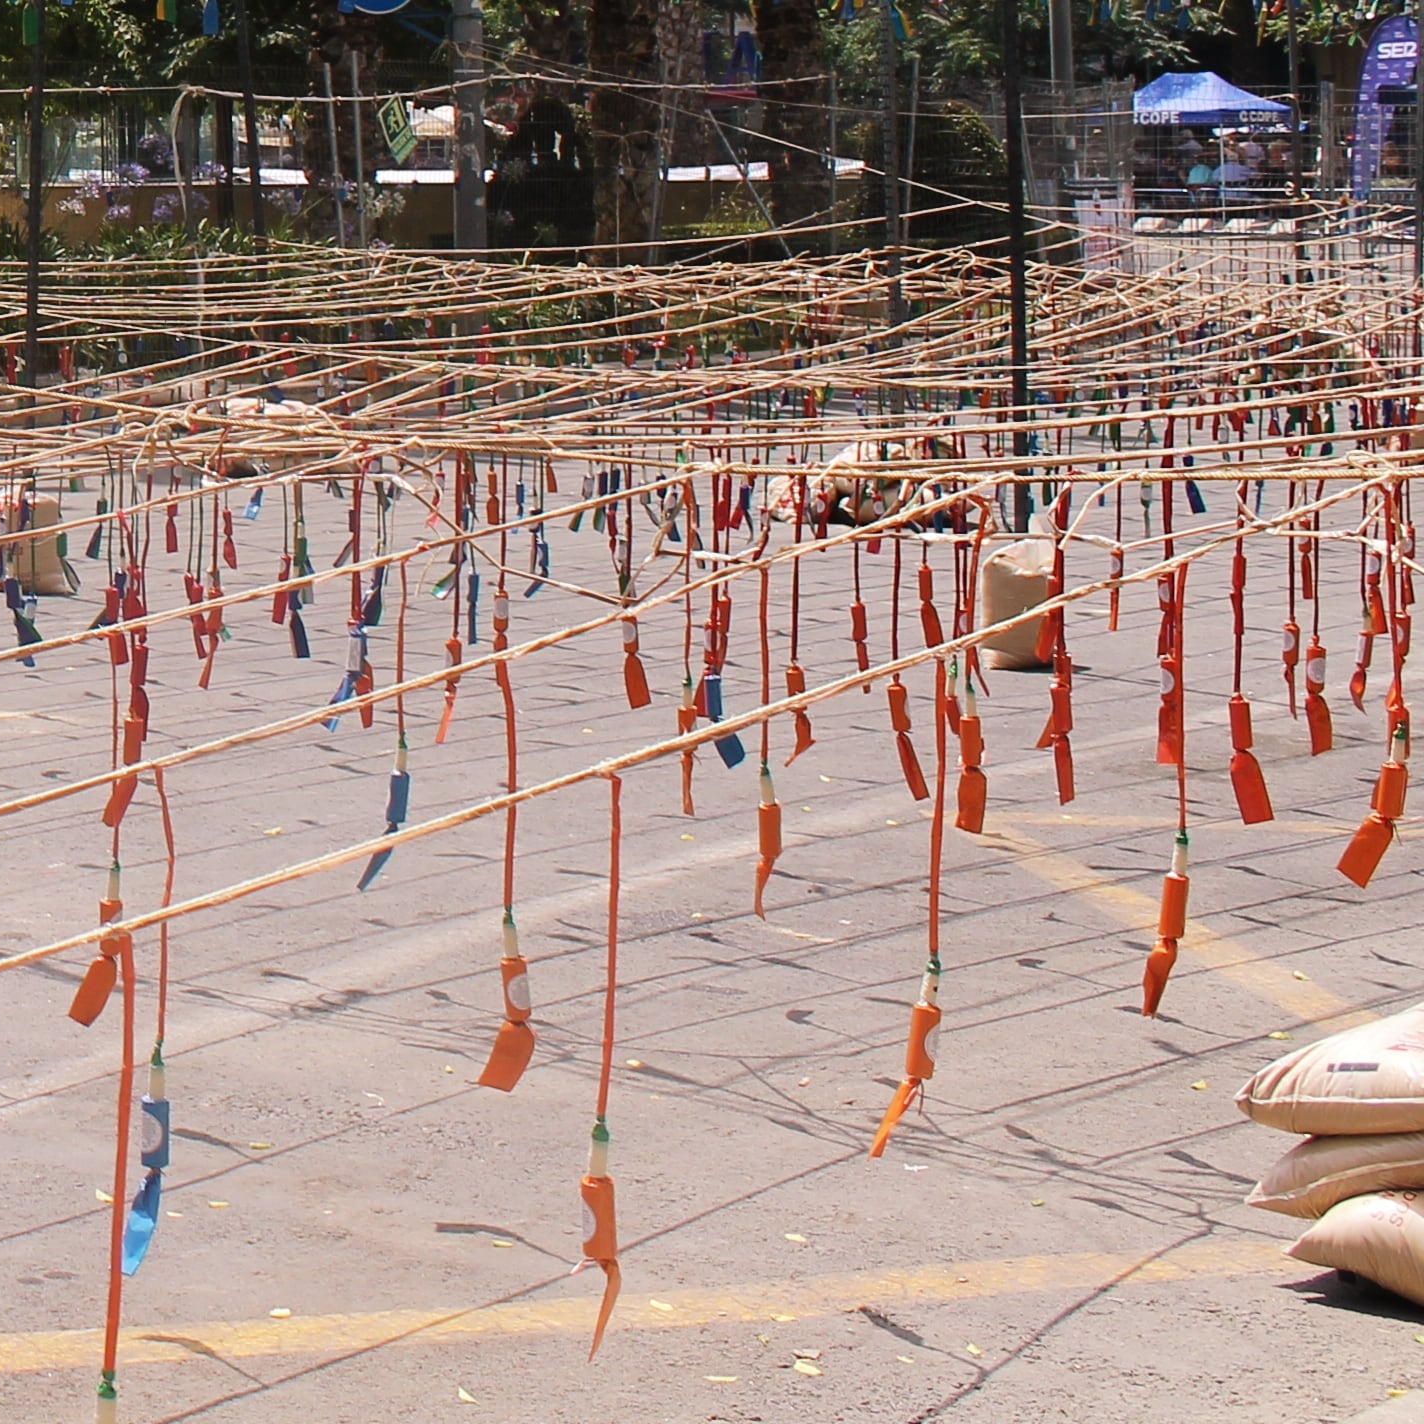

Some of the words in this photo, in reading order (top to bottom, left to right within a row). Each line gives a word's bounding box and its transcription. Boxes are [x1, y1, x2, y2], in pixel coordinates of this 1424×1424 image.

[1376, 41, 1418, 59] SER
[1139, 111, 1180, 125] COPE
[1251, 111, 1278, 123] COPE
